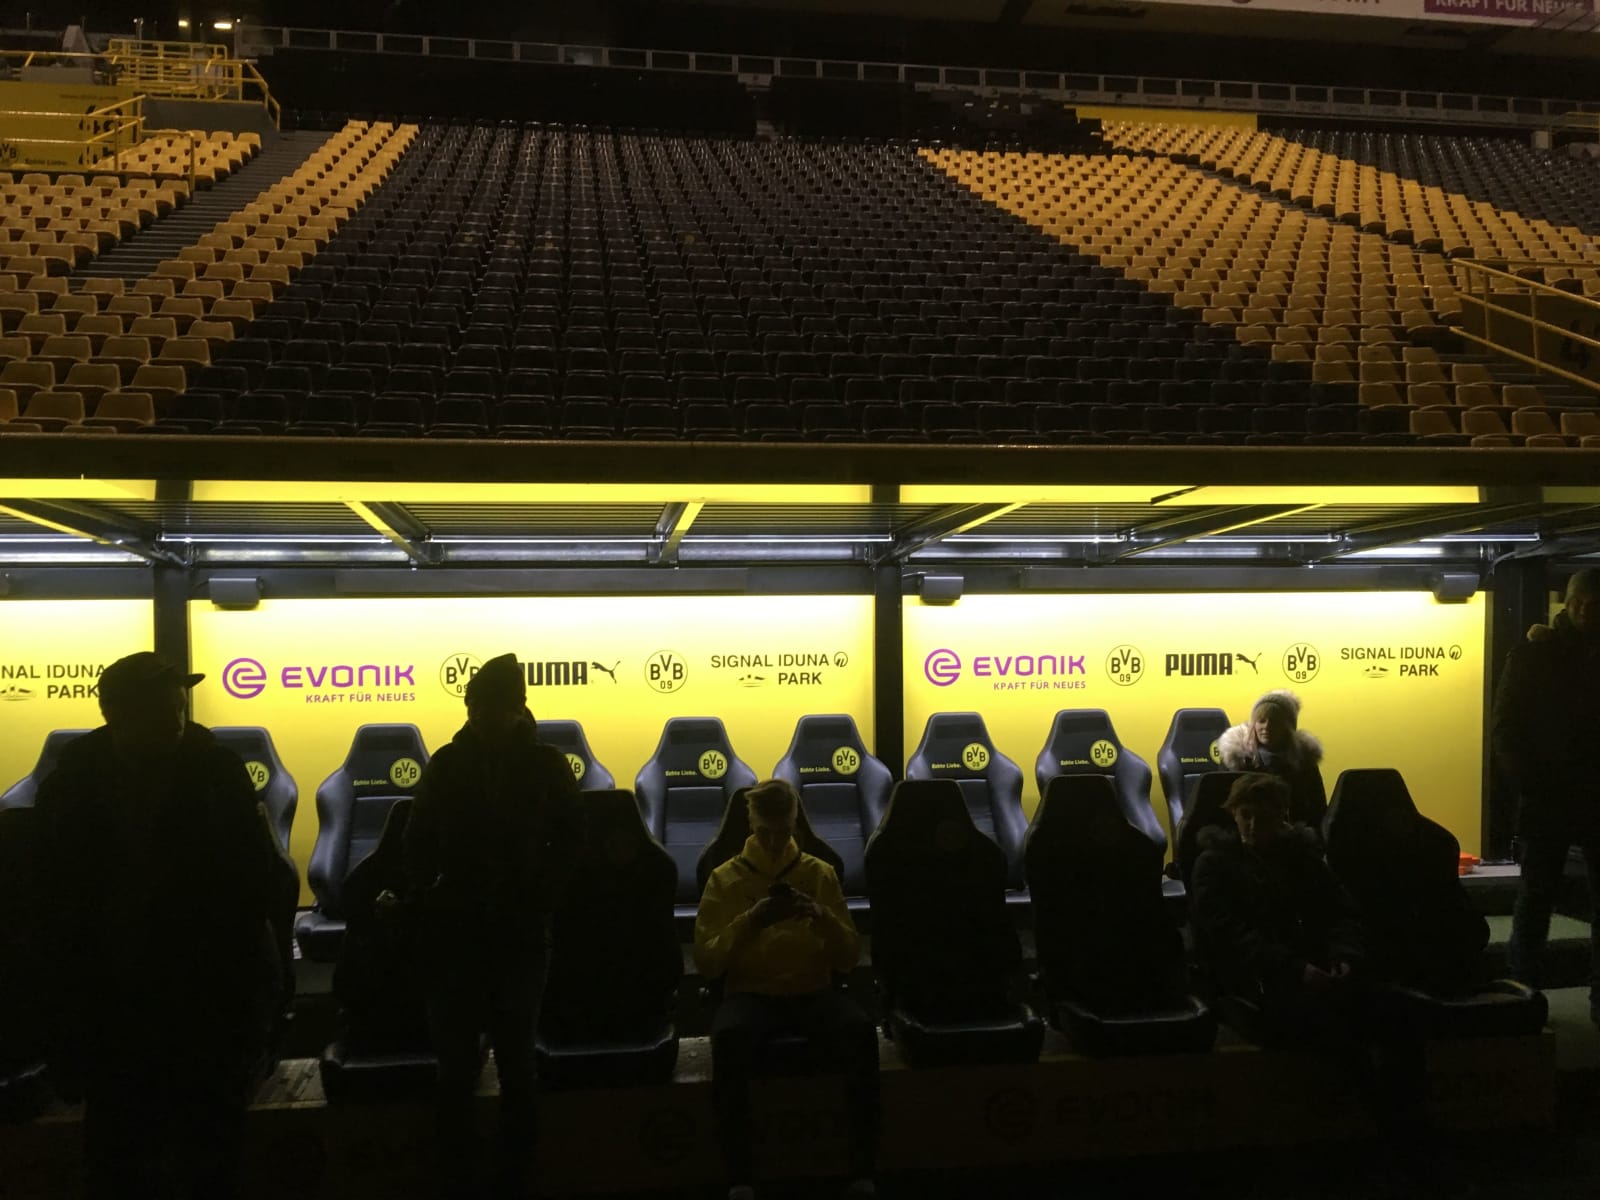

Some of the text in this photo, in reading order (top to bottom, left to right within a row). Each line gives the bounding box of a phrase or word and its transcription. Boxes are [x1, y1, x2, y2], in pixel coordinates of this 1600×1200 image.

[711, 653, 830, 668] SIGNAL IDUNA
[1111, 648, 1141, 674] BVB
[1287, 646, 1317, 671] BVB
[1341, 646, 1446, 660] SIGNAL IDUNA
[649, 655, 684, 680] BVB
[973, 655, 1087, 677] EVONIK
[1165, 653, 1233, 677] PUMA
[1400, 664, 1439, 677] PARK
[281, 665, 416, 688] EVONIK
[517, 662, 588, 687] UMA
[778, 672, 823, 686] PARK
[1120, 674, 1131, 683] 09
[1295, 671, 1307, 680] 09
[47, 684, 100, 699] PARK
[659, 680, 674, 689] 09
[1053, 680, 1087, 689] NEUES
[305, 691, 416, 704] KRAFT FÜR NEUES
[836, 750, 857, 766] BVB
[966, 746, 986, 762] BVB
[1094, 743, 1114, 759] BVB
[703, 753, 724, 770] BVB
[395, 762, 417, 779] BVB
